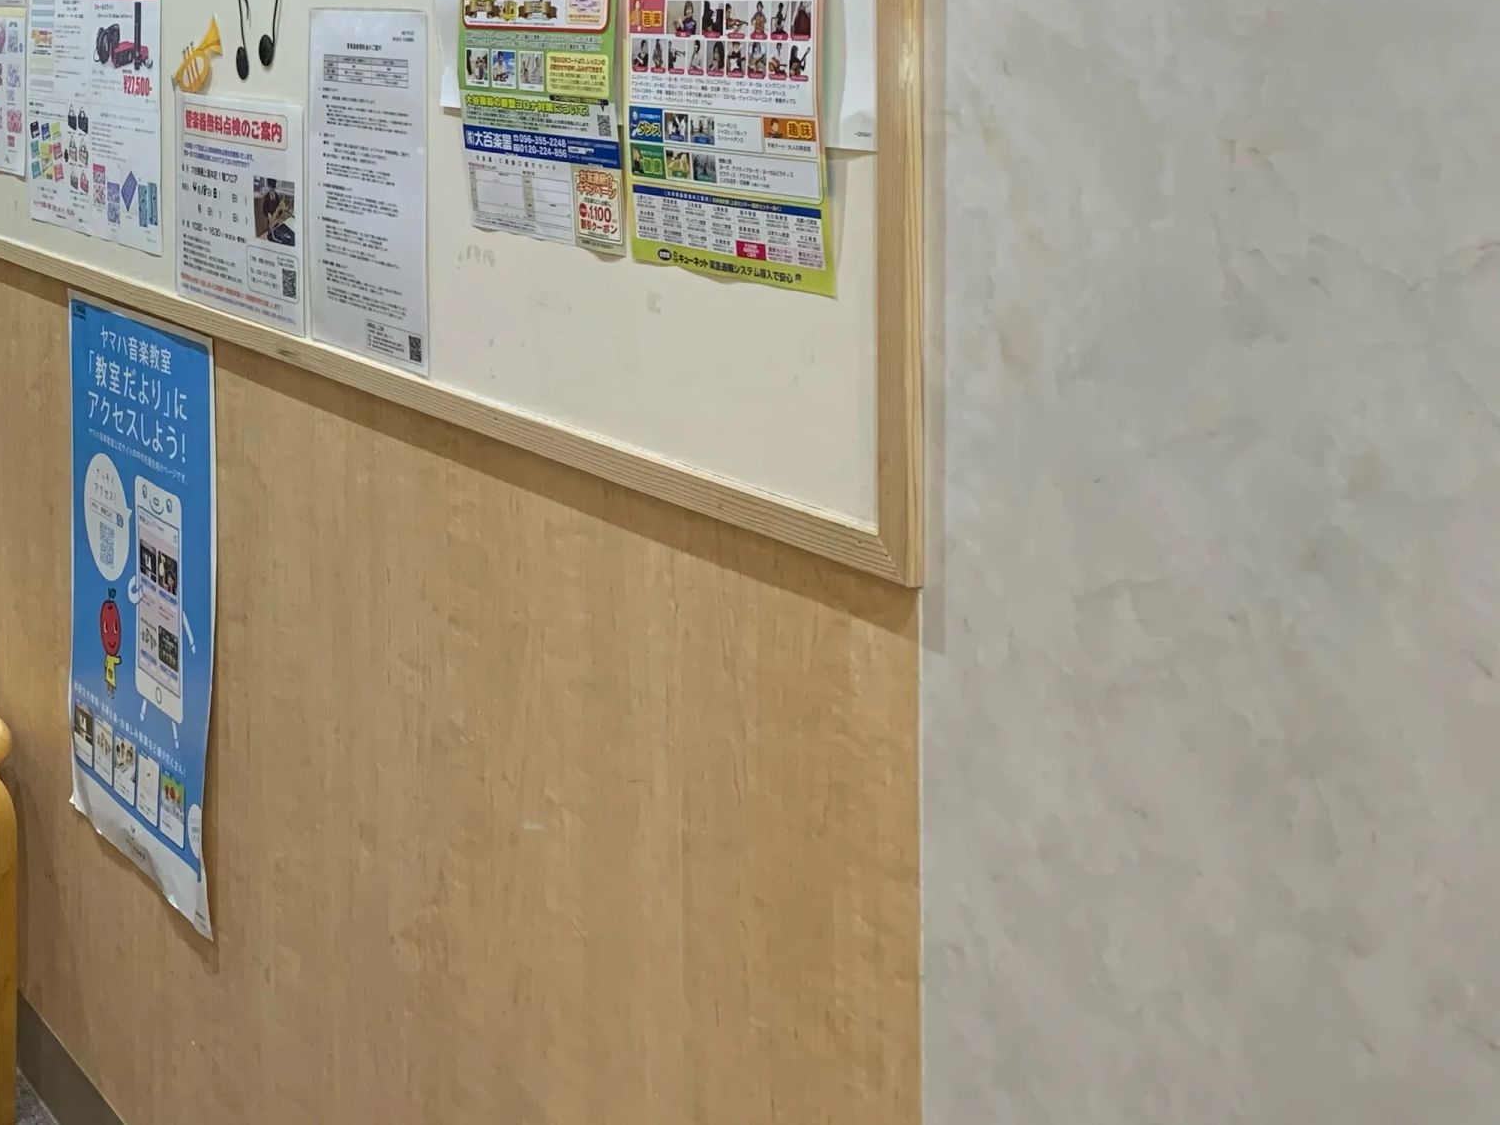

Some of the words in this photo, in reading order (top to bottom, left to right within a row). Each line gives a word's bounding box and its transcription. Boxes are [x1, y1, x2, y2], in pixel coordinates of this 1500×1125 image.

[643, 11, 663, 27] 音楽
[638, 122, 661, 138] ダンス
[787, 121, 813, 139] 趣味
[678, 253, 708, 267] キューネット
[100, 326, 171, 375] ヤマハ音楽教室
[88, 350, 188, 420] 「教室だより」に
[88, 391, 186, 463] アクセスしよう！
